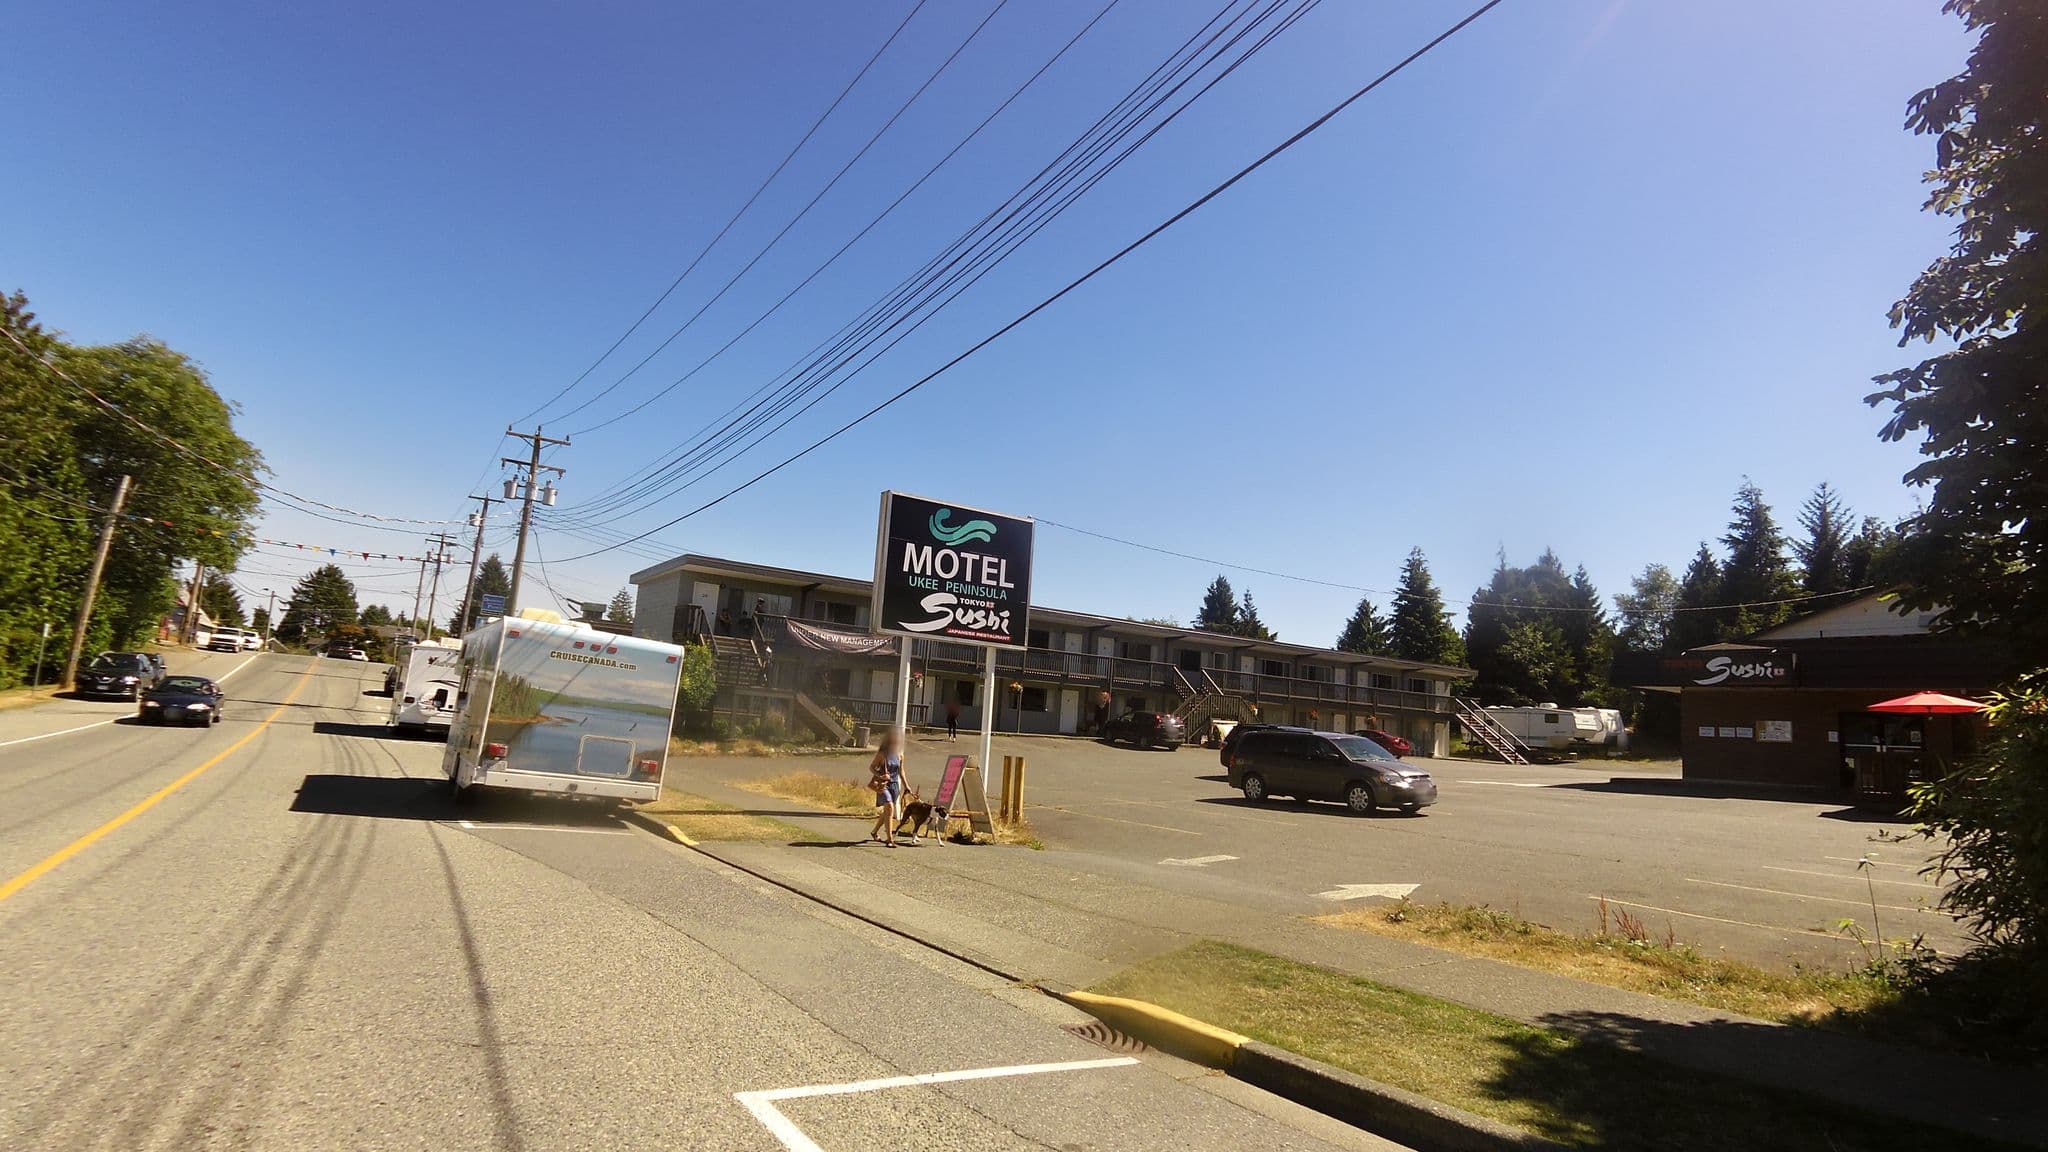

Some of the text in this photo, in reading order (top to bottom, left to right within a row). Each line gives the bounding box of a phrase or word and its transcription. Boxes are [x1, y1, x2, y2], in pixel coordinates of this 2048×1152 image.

[903, 542, 1015, 589] MOTEL
[909, 575, 1007, 600] UKEE PENINSULA
[898, 592, 1011, 635] Sushi
[960, 597, 986, 608] TOKYO
[821, 633, 839, 643] NEW
[947, 628, 1011, 641] JAPANESE RESTAURANT
[550, 650, 638, 671] CRUISECANADA.com
[1692, 656, 1775, 685] Sushi
